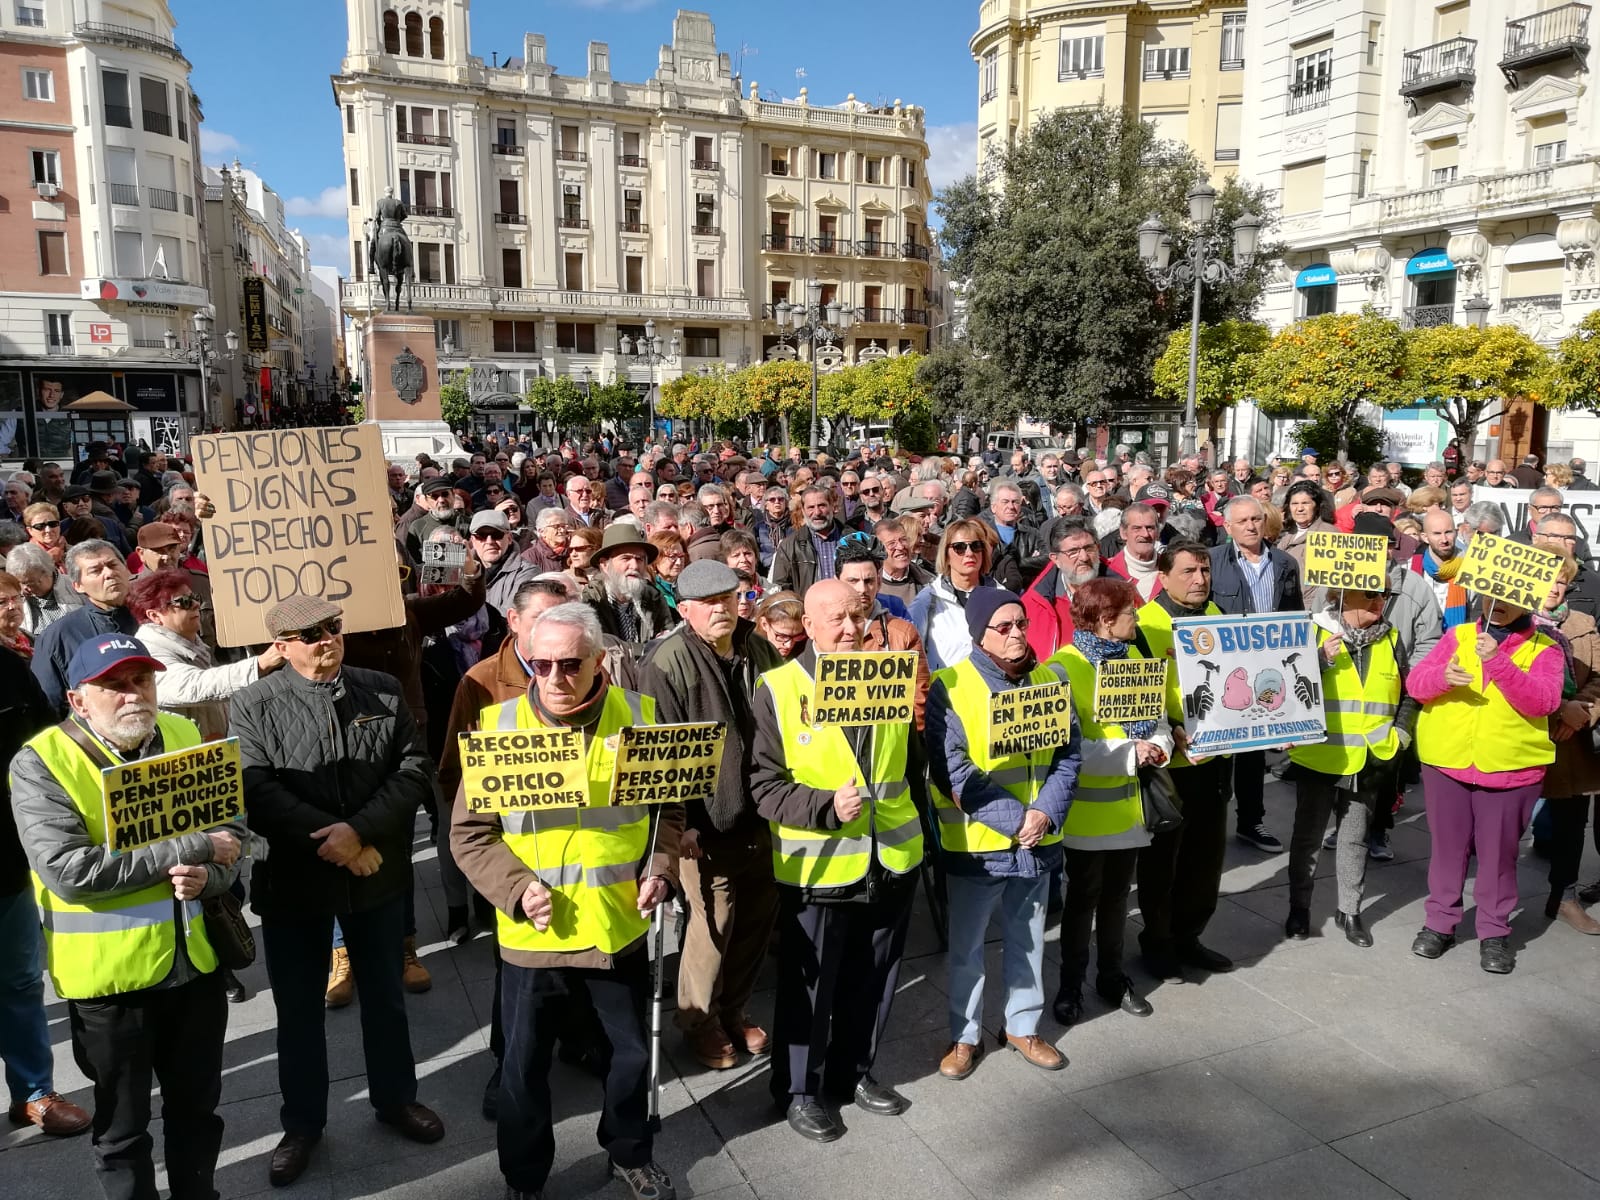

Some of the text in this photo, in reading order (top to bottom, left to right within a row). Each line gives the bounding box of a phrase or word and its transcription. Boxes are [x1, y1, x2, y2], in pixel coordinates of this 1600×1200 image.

[249, 294, 263, 339] EMFISA
[198, 427, 362, 474] PENSIONES
[227, 467, 357, 513] DIGNAS
[211, 511, 376, 560] DERECHO DE
[1309, 534, 1384, 552] LAS PENSIONES
[1314, 549, 1377, 563] NO SON
[1476, 533, 1560, 569] YO COTIZO
[1334, 560, 1355, 572] UN
[1470, 546, 1554, 583] TÚ COTIZAS
[222, 555, 353, 607] TODOS
[1307, 569, 1382, 590] NEGOCIO
[1477, 565, 1536, 592] Y ELLOS
[1455, 571, 1543, 610] ROBAN
[97, 640, 137, 655] FILA
[1217, 621, 1310, 654] BUSCAN
[820, 655, 915, 681] PERDÓN
[1101, 661, 1165, 676] MILLONES PARA
[823, 684, 907, 701] POR VIVIR
[1100, 674, 1164, 689] GOBERNANTES
[1001, 685, 1061, 706] MI FAMILIA
[1099, 692, 1162, 707] HAMBRE PARA
[815, 704, 910, 723] DEMASIADO
[992, 698, 1067, 725] EN PARO
[1045, 717, 1058, 728] LA
[1098, 704, 1162, 719] COTIZANTES
[467, 732, 576, 753] RECORTE
[623, 726, 722, 747] PENSIONES
[993, 728, 1067, 756] MANTENGO?
[1192, 718, 1324, 745] LADRONES DE PENSIONES
[466, 754, 486, 768] DE
[494, 749, 580, 767] PENSIONES
[626, 743, 714, 763] PRIVADAS
[121, 747, 224, 786] DE NUESTRAS
[616, 765, 717, 788] PERSONAS
[109, 761, 238, 809] PENSIONES
[481, 771, 565, 793] OFICIO
[614, 782, 714, 803] ESTAFADAS
[111, 780, 239, 826] VIVEN MUCHOS
[471, 790, 584, 810] DE LADRONES
[115, 796, 240, 850] MILLONES
